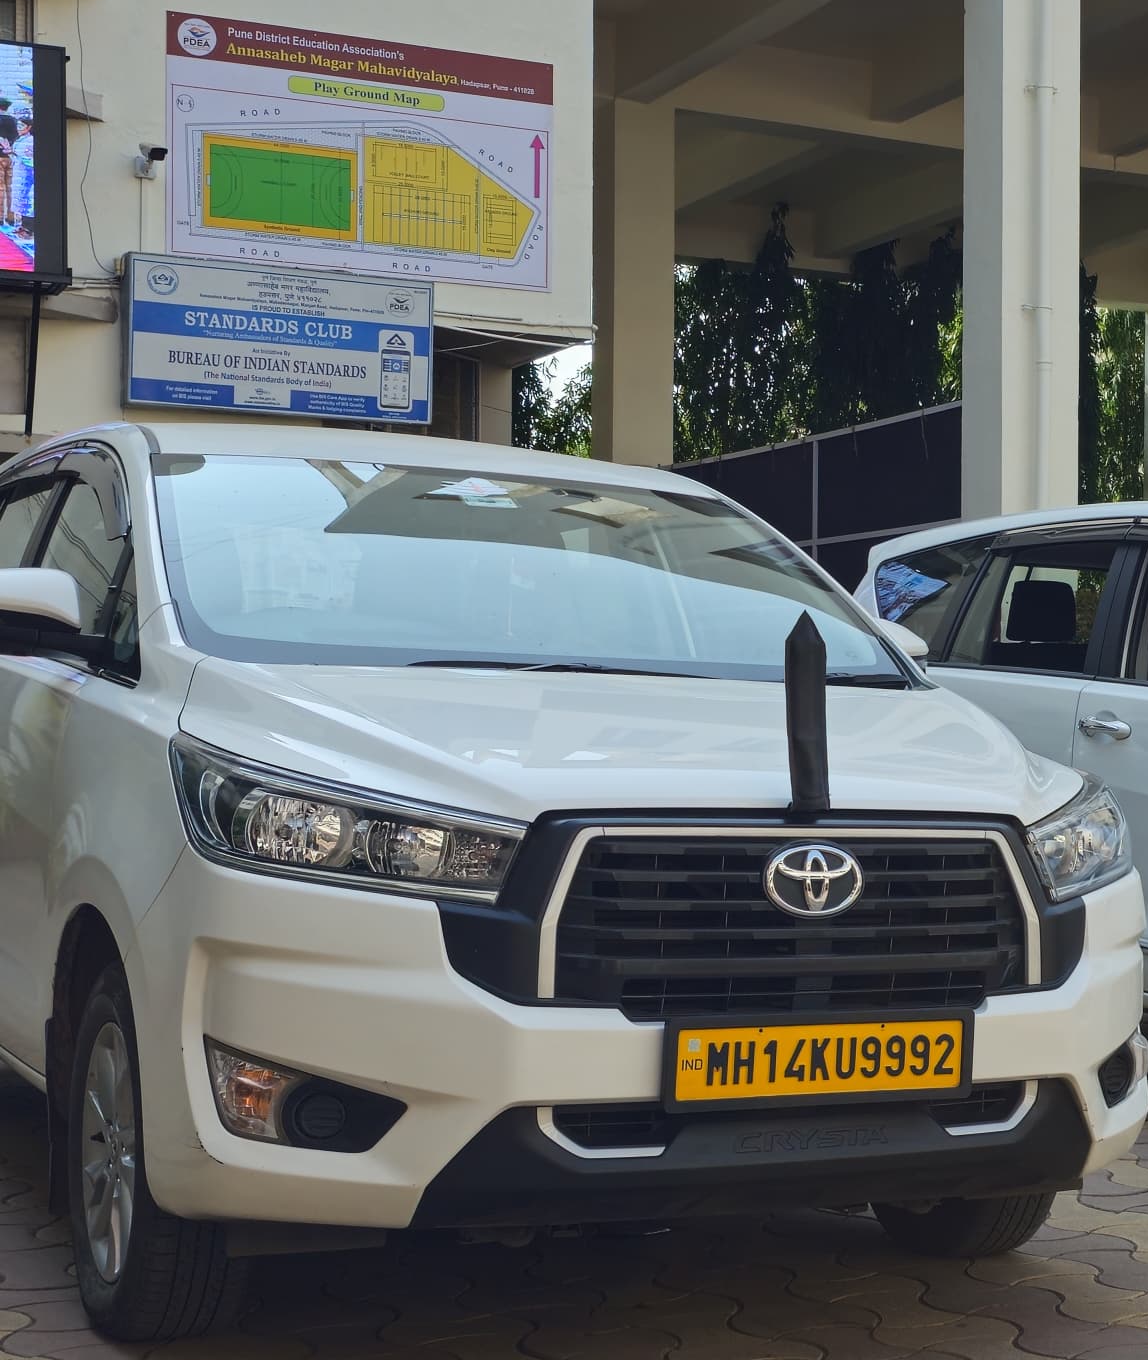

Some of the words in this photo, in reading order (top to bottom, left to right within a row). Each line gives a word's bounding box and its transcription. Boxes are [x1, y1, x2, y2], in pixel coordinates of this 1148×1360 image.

[183, 38, 210, 48] PDEA
[226, 43, 307, 64] Annasaheb
[310, 53, 354, 71] Magar
[228, 27, 253, 40] Pune
[255, 31, 290, 45] District
[292, 36, 340, 52] Education
[342, 43, 405, 61] Association's
[314, 81, 340, 97] Play
[343, 86, 389, 101] Ground
[393, 92, 420, 106] Map
[292, 308, 325, 317] ESTABLISH
[390, 304, 410, 312] PDEA
[184, 311, 298, 335] STANDARDS
[304, 322, 353, 340] CLUB
[168, 350, 220, 367] BUREAU
[224, 355, 241, 369] OF
[244, 356, 290, 373] INDIAN
[293, 360, 367, 379] STANDARDS
[204, 371, 219, 380] (The
[221, 372, 250, 382] National
[251, 374, 285, 384] Standards
[286, 377, 303, 387] Body
[312, 380, 332, 389] India)
[681, 1058, 703, 1071] IND
[705, 1033, 956, 1087] MH14KU9992
[735, 1124, 890, 1155] CRYSTA
